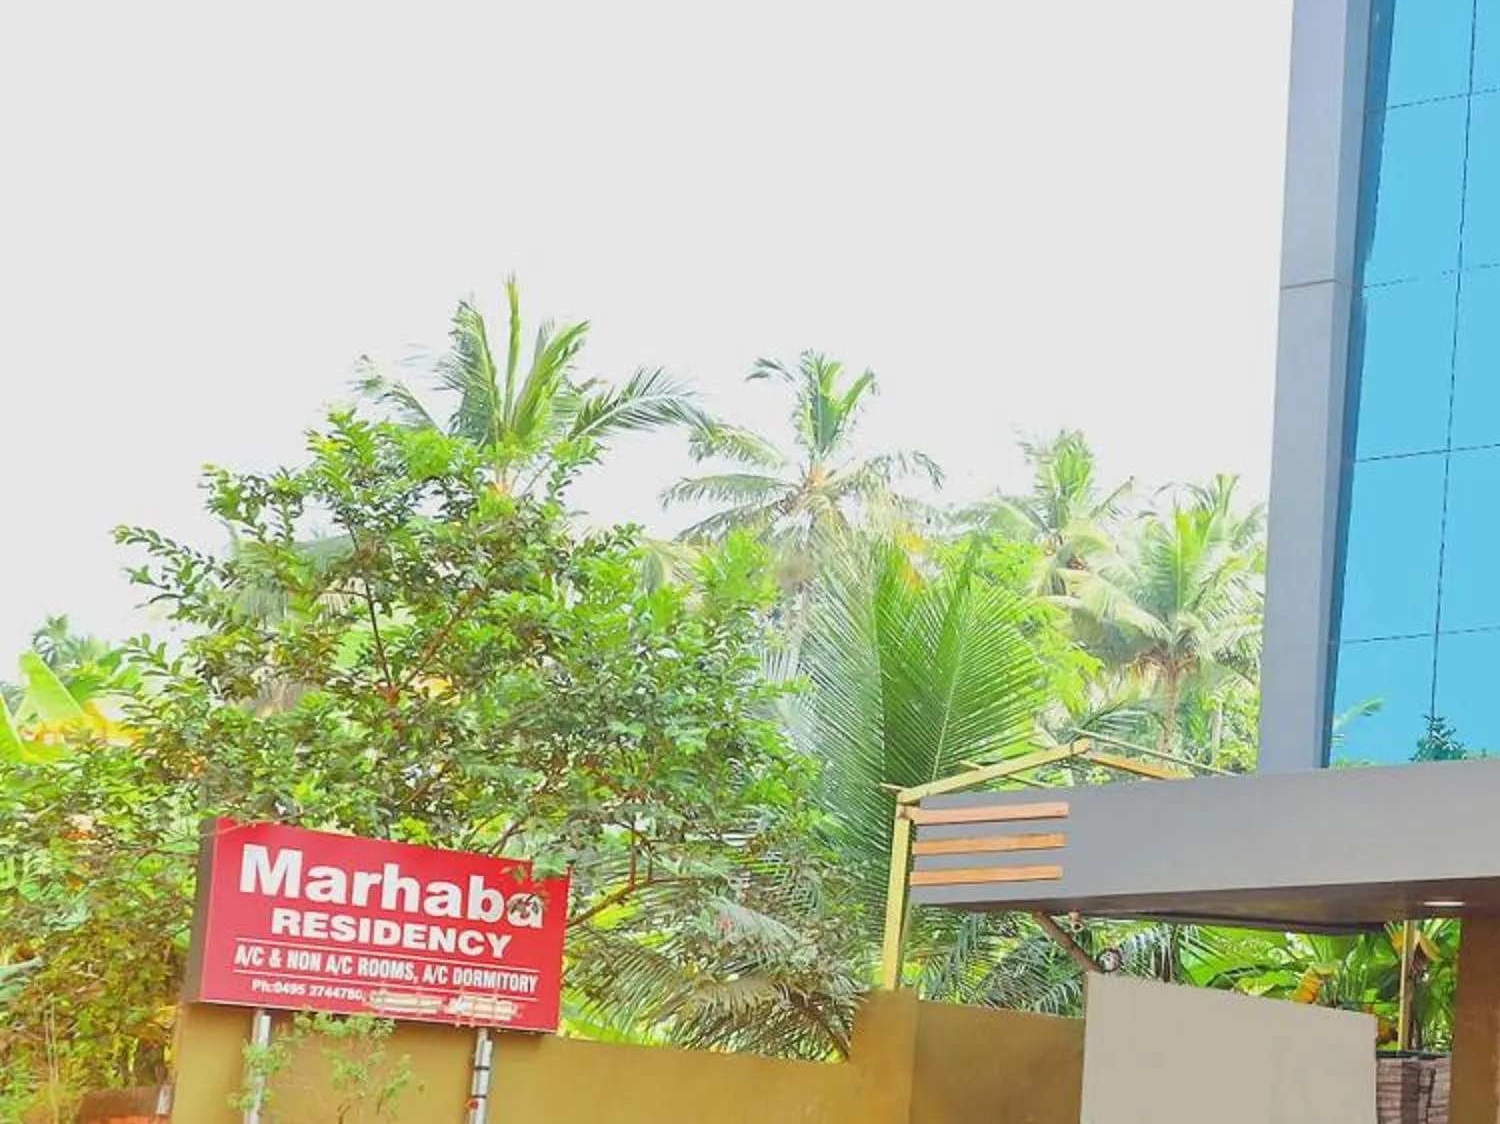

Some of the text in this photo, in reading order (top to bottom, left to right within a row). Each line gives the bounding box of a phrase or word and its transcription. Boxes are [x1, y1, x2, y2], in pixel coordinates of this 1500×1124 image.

[239, 843, 544, 929] Marhaba
[271, 907, 512, 959] RESIDENCY
[234, 944, 539, 993] A/C & NON A/C ROOMS, A/C DORMITORY
